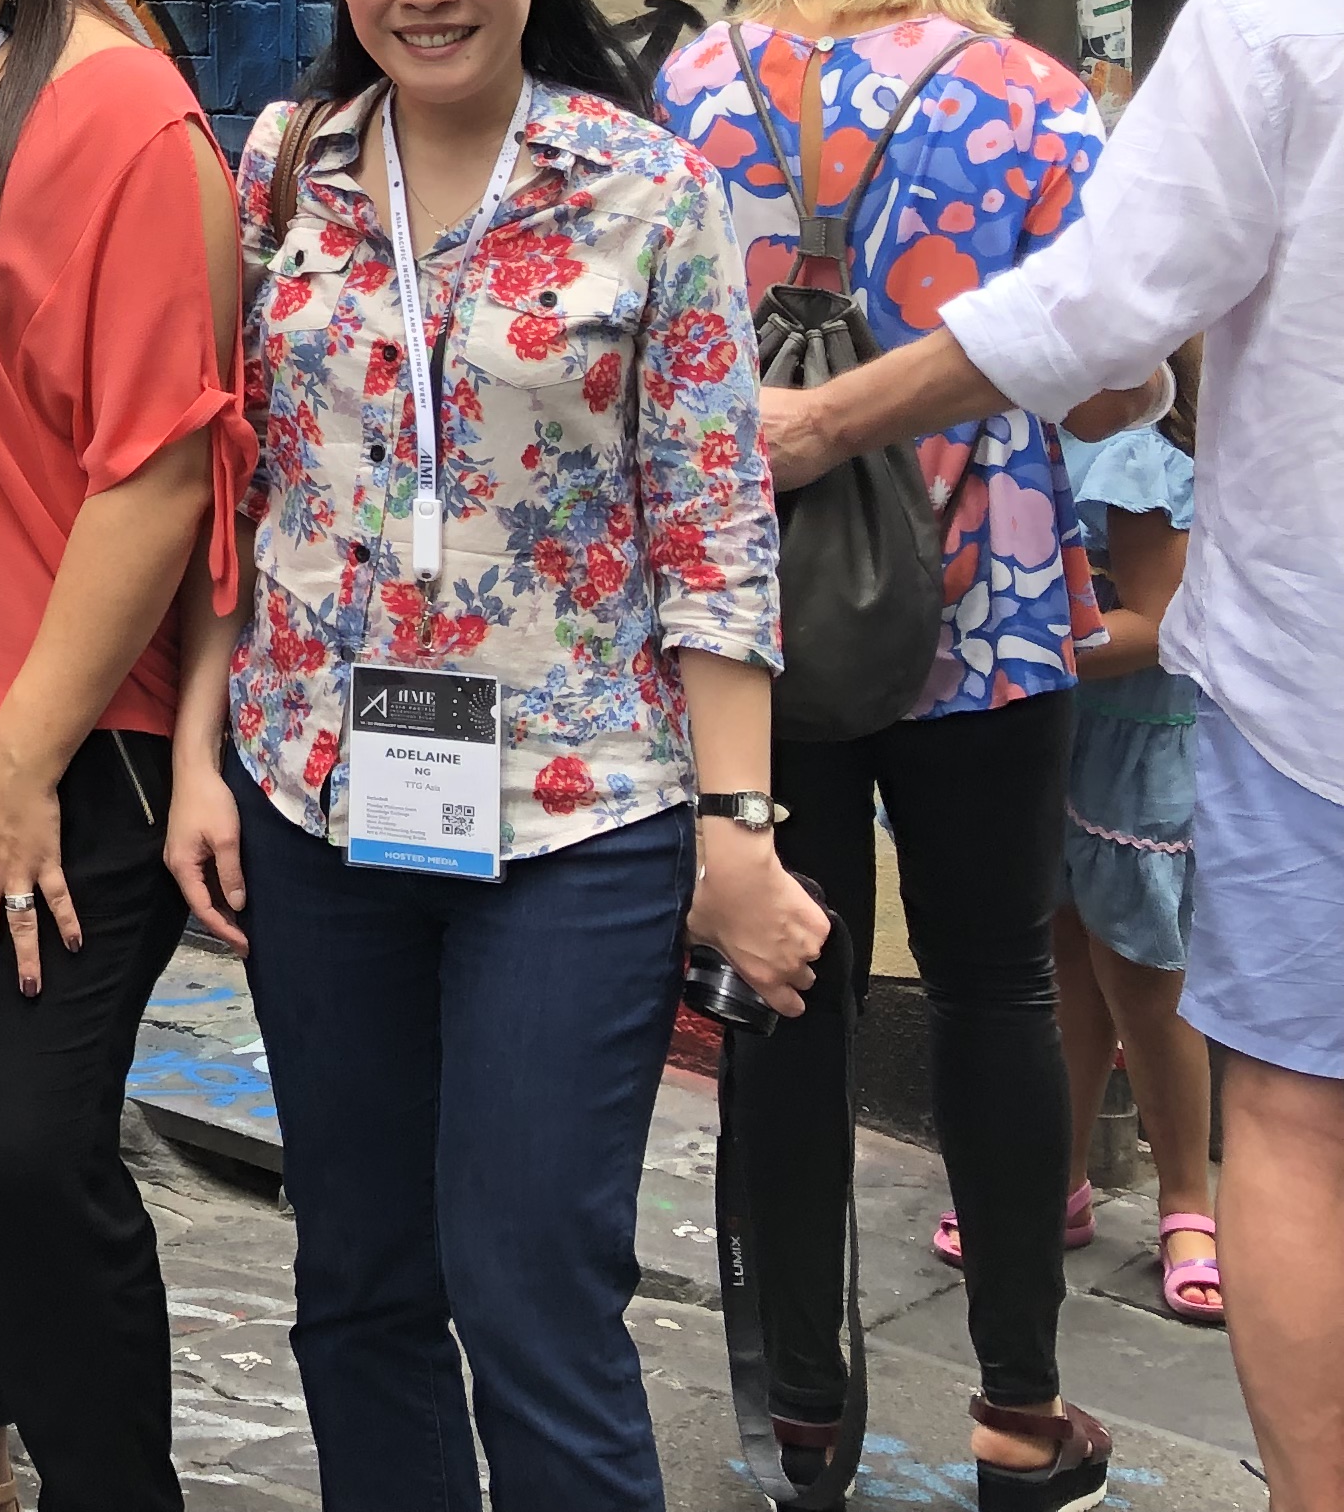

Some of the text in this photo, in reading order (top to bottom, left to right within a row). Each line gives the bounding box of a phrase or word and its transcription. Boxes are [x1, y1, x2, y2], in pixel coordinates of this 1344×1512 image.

[394, 211, 427, 410] ASIA PACIFIC INCENTIVES AND MEETINGS EVENT
[419, 447, 432, 491] AIME
[385, 747, 461, 766] ADELAINE
[414, 767, 431, 777] NG
[404, 780, 423, 790] TTG
[384, 851, 459, 867] HOSTED MEDIA
[731, 1235, 744, 1288] LUMIX
